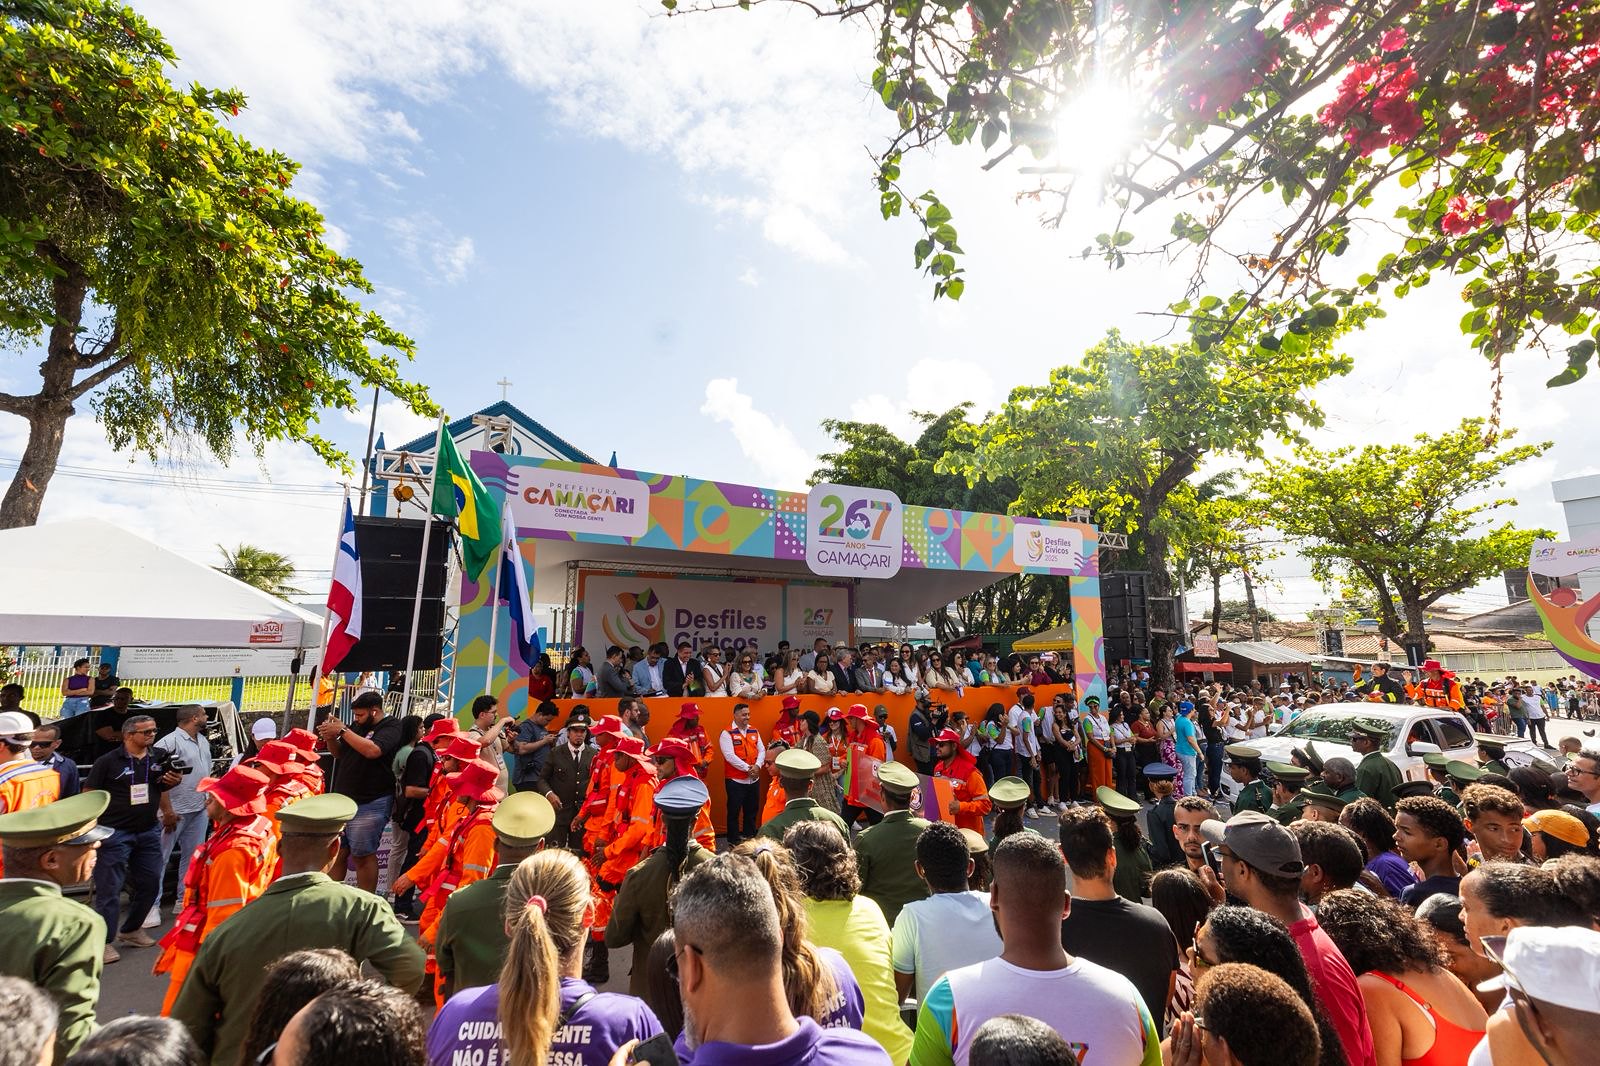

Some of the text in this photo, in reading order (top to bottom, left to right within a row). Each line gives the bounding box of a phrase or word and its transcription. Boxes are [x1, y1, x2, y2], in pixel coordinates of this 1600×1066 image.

[549, 482, 617, 495] PREFEITURA
[523, 487, 634, 514] CAMAÇARI
[819, 495, 893, 540] 267
[1045, 537, 1071, 547] Desfiles
[1535, 547, 1556, 558] 267
[817, 550, 891, 570] CAMAÇARI
[675, 608, 767, 631] Desfiles
[803, 608, 834, 626] 267
[458, 1022, 592, 1044] CUIDA ENTE
[487, 1043, 499, 1066] É
